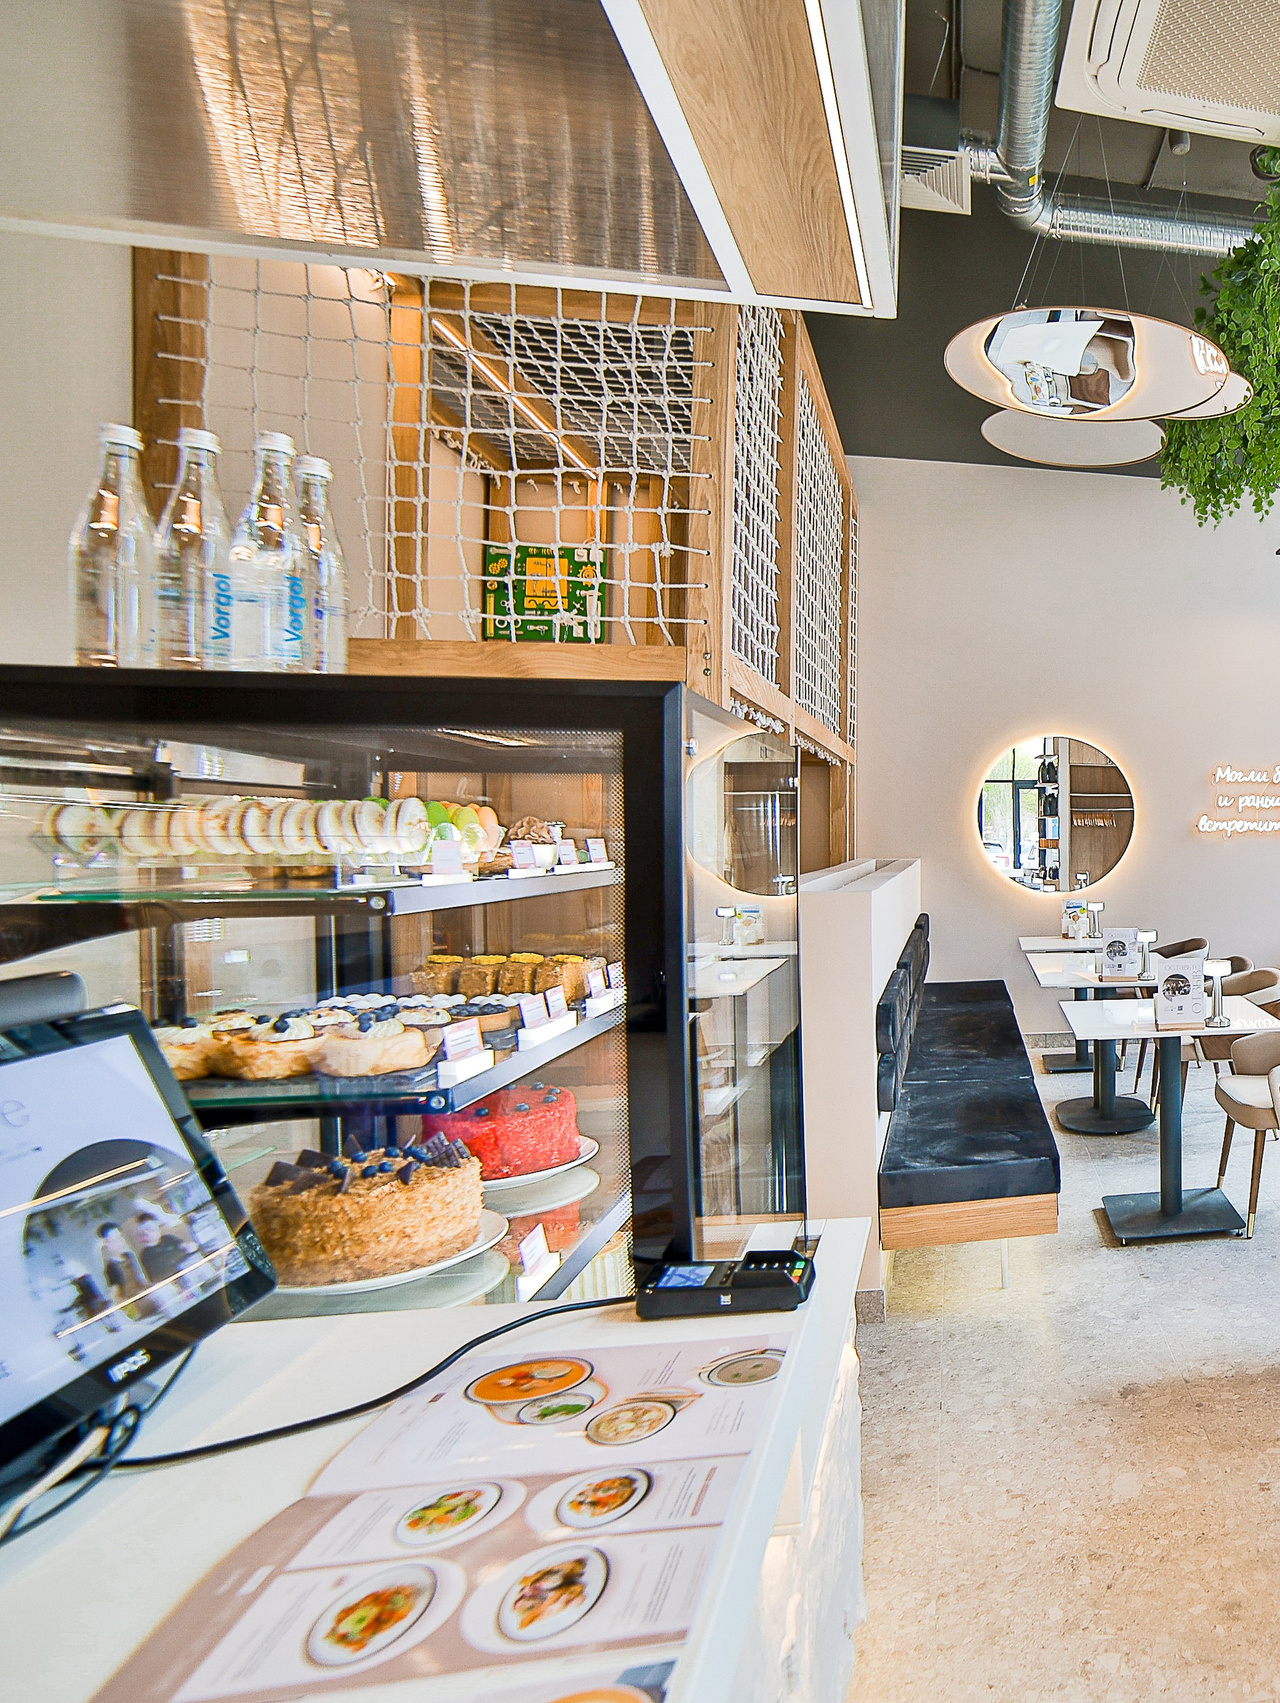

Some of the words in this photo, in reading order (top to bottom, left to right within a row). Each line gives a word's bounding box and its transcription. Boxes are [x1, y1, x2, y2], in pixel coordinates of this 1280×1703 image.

[211, 573, 234, 640] Vorgol
[283, 575, 307, 642] Vorgol
[1214, 764, 1271, 783] Могли
[1217, 794, 1236, 808] и
